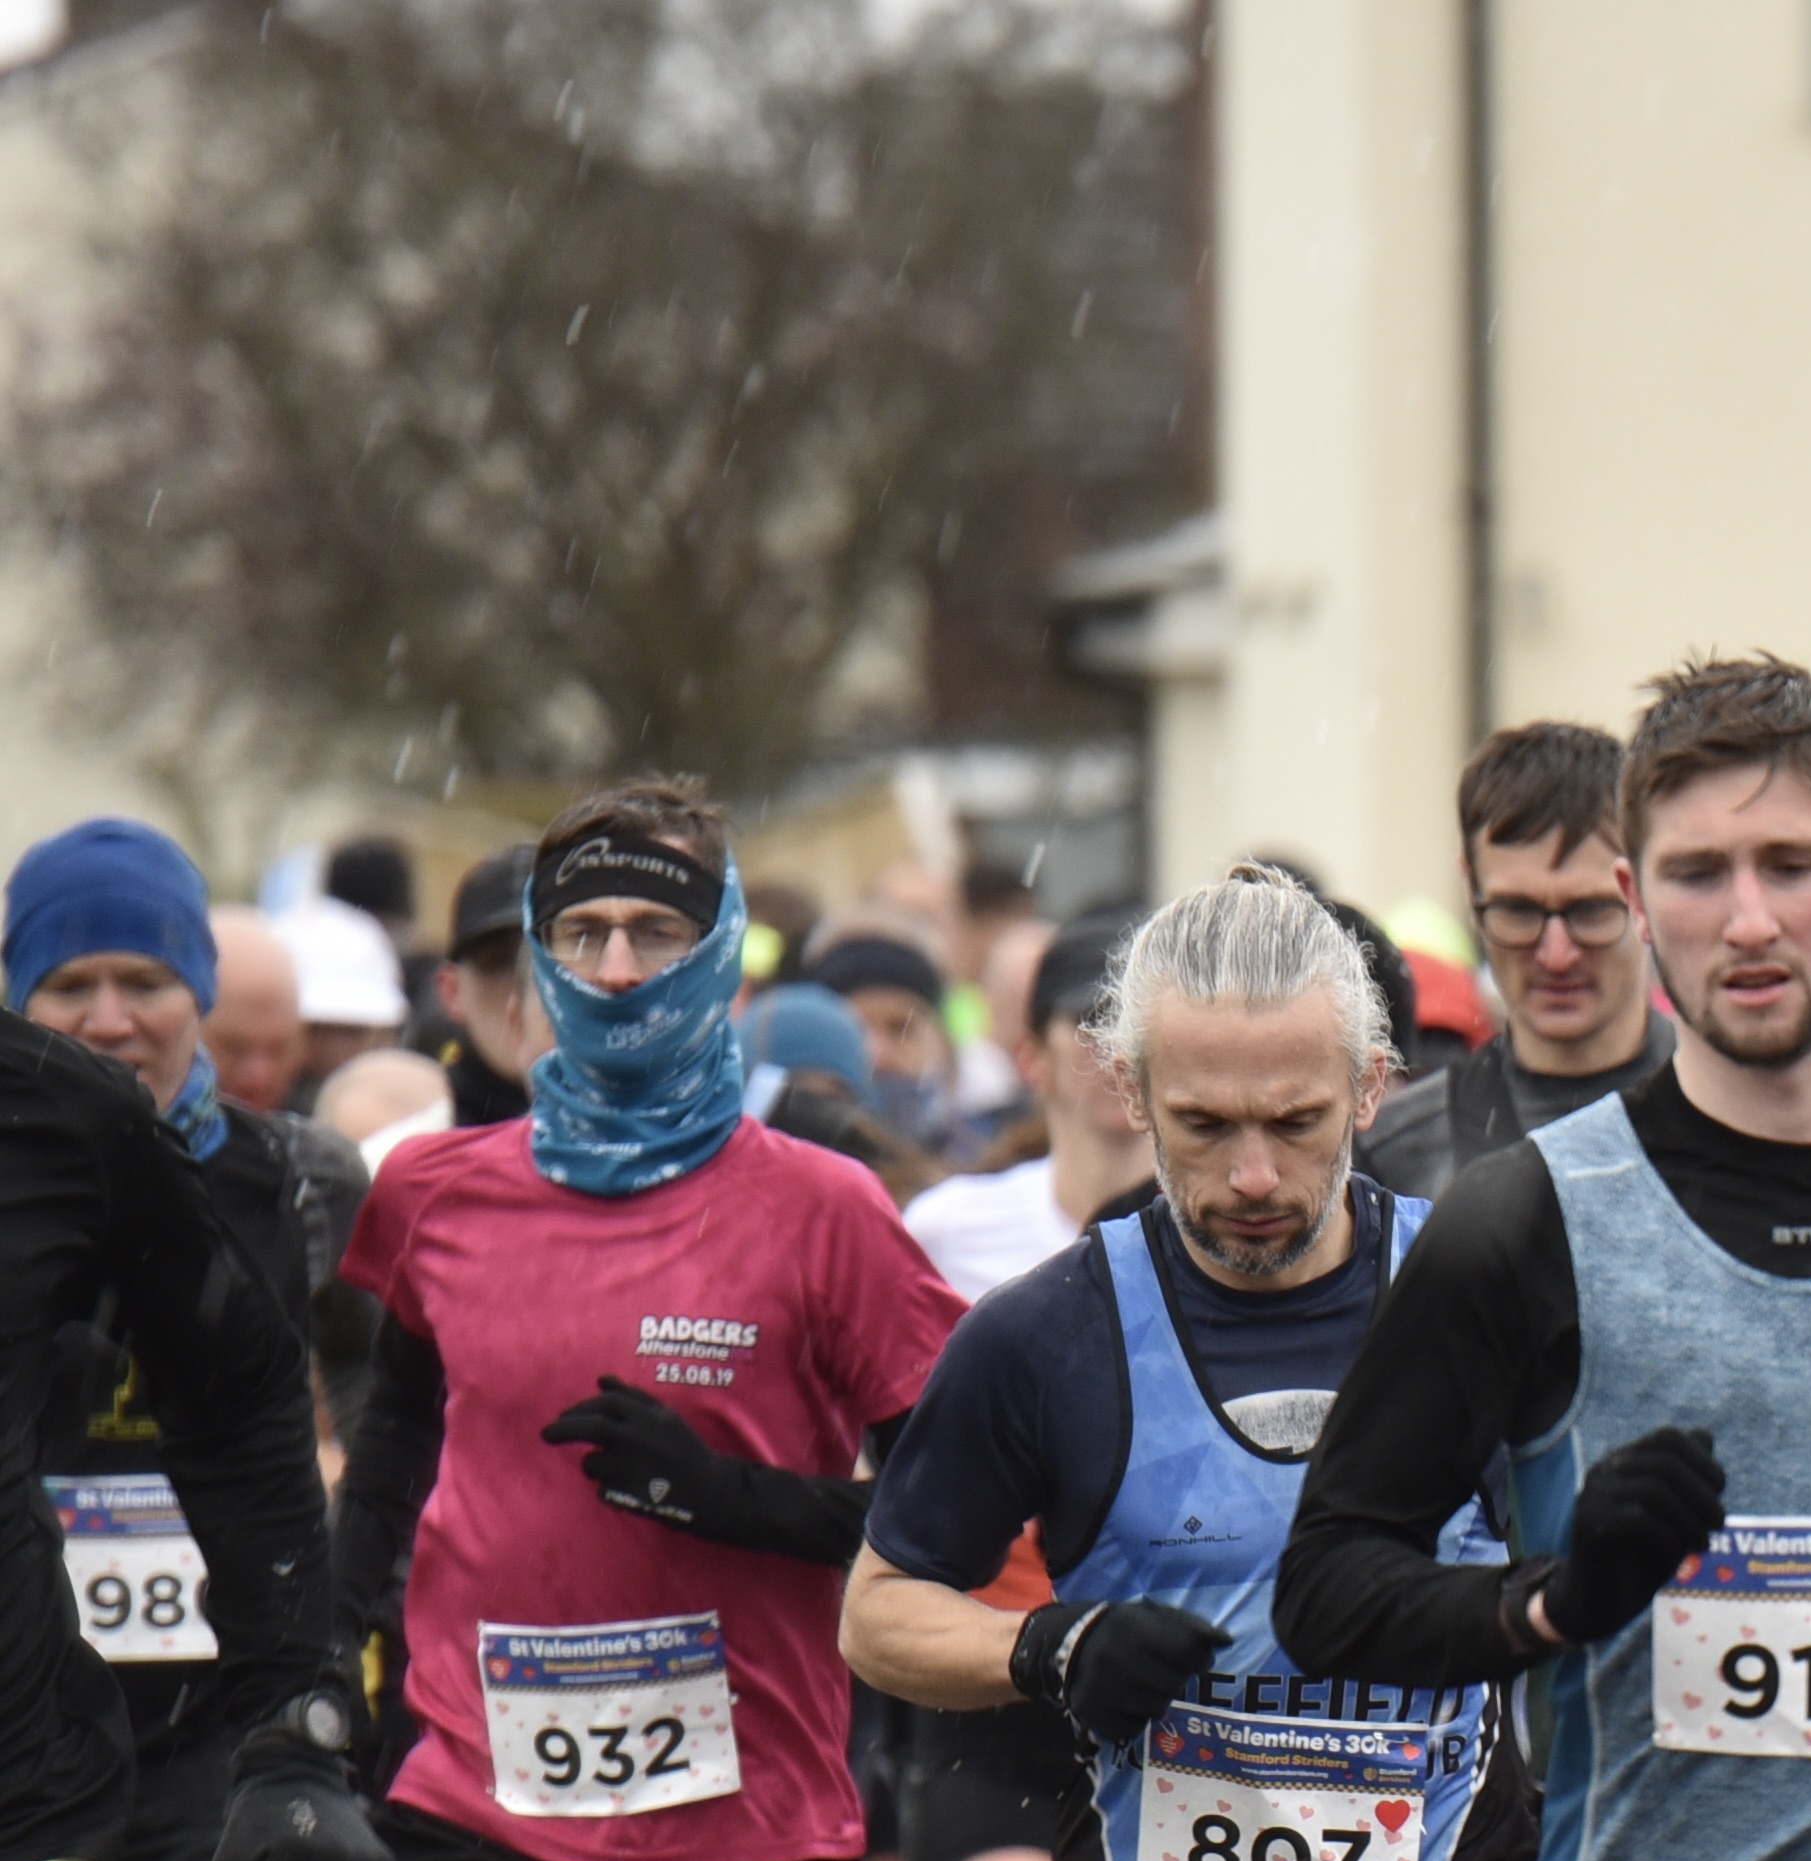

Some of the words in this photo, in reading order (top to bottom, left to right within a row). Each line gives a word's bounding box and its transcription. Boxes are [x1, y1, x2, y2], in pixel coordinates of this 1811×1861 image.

[640, 1315, 758, 1347] BADGERS
[87, 1573, 209, 1629] 98
[508, 1637, 531, 1657] St
[532, 1634, 642, 1659] Valentine's
[534, 1716, 691, 1787] 932
[1187, 1717, 1211, 1737] St
[1214, 1721, 1341, 1754] Valentine's
[1345, 1731, 1391, 1755] 30k
[1225, 1747, 1290, 1766] Stamford
[1292, 1754, 1349, 1770] Striders
